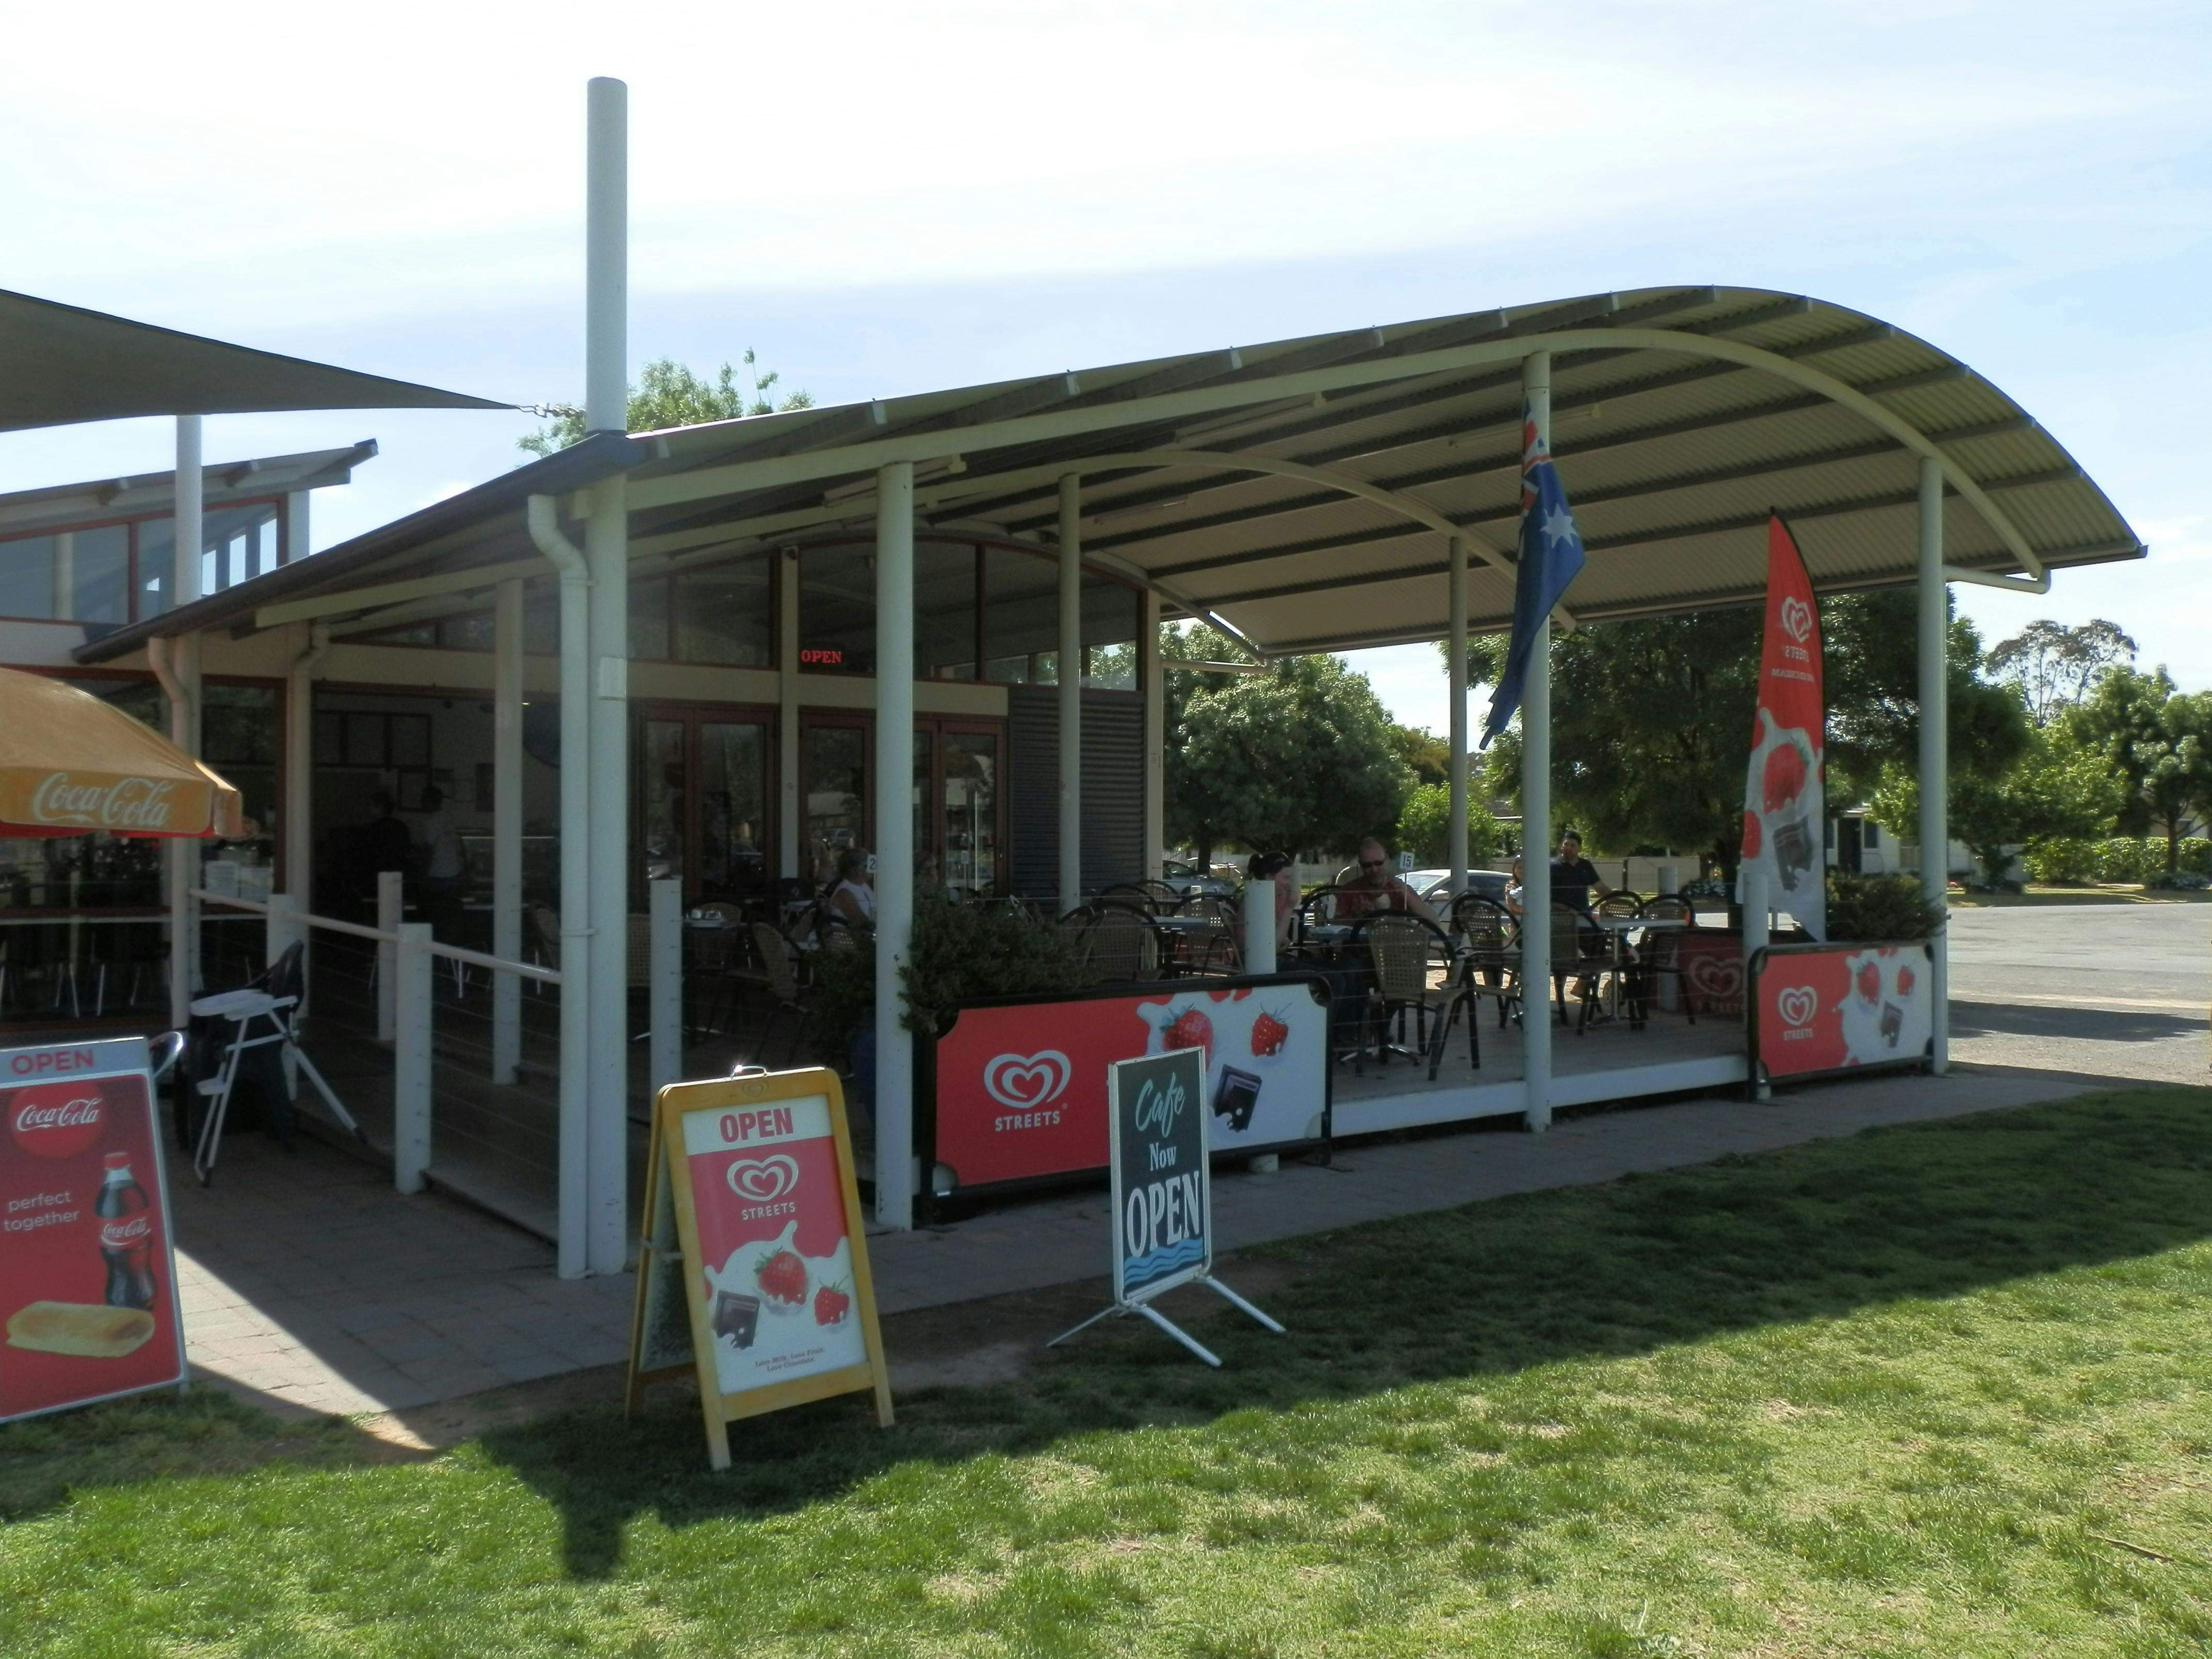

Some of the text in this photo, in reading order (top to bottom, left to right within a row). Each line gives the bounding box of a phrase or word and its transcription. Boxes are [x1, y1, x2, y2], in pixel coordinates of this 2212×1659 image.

[801, 650, 842, 663] OPEN
[32, 772, 174, 826] Coca-Cola
[1403, 855, 1411, 867] 15
[11, 1049, 94, 1076] OPEN
[17, 1097, 103, 1131] Coca-Cola
[1135, 1072, 1185, 1138] Cafe
[720, 1108, 793, 1143] OPEN
[995, 1111, 1060, 1132] STREETS
[1149, 1142, 1177, 1171] Now
[9, 1191, 72, 1213] perfect
[742, 1202, 795, 1221] STREETS
[1127, 1170, 1200, 1258] OPEN
[4, 1211, 79, 1231] together
